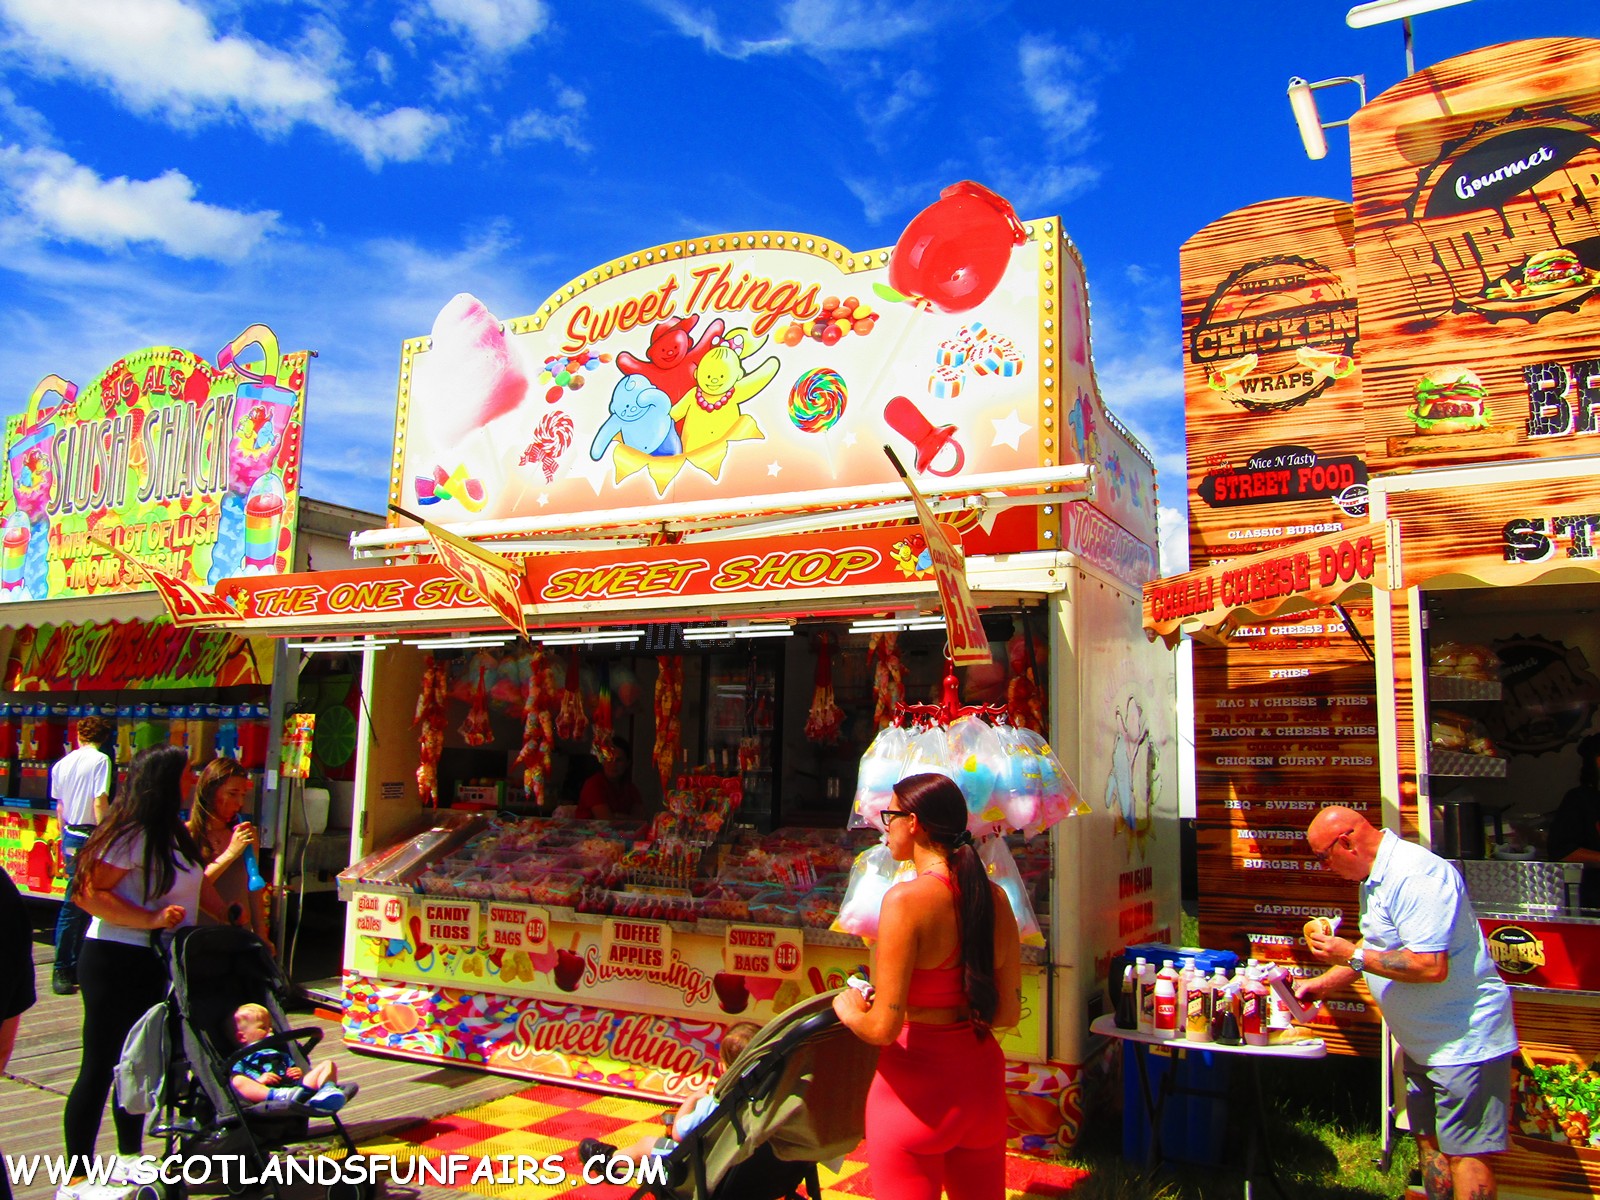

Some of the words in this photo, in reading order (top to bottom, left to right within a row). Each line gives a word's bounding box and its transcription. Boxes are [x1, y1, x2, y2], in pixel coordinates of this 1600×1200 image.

[1454, 146, 1554, 200] Gourmet
[561, 273, 679, 353] Sweet
[685, 261, 822, 336] Things
[1195, 309, 1359, 359] CHICKEN
[102, 376, 134, 413] BIG
[143, 364, 185, 397] AL'S
[1239, 371, 1315, 394] WRAPS
[49, 414, 133, 516] SLUSH
[138, 395, 234, 502] SHACK
[1249, 455, 1272, 470] Nice
[1274, 454, 1286, 467] N
[1287, 452, 1317, 469] Tasty
[1214, 470, 1291, 500] STREET
[1297, 463, 1355, 493] FOOD
[47, 534, 59, 561] A
[115, 524, 146, 553] LOT
[149, 521, 171, 550] OF
[171, 513, 221, 548] LUSH
[1228, 526, 1283, 540] CLASSIC
[1286, 522, 1343, 536] BURGER
[70, 561, 87, 590] IN
[87, 557, 120, 588] OUR
[255, 587, 323, 615] THE
[329, 583, 410, 610] ONE
[415, 575, 520, 608] STO
[544, 562, 705, 599] SWEET
[711, 548, 881, 589] SHOP
[1151, 575, 1215, 623] CHILLI
[1220, 551, 1311, 608] CHEESE
[1318, 536, 1376, 586] DOG
[1234, 626, 1266, 637] ILLI
[1269, 624, 1324, 635] CHEESE
[1327, 622, 1347, 634] DO
[1269, 668, 1309, 679] FRIES
[1216, 698, 1245, 709] MAC
[1250, 699, 1261, 708] N
[1264, 697, 1318, 708] CHEESE
[1327, 696, 1369, 706] FRIES
[1235, 712, 1290, 723] PULLED
[1210, 726, 1256, 738] BACON
[1260, 727, 1272, 738] &
[1276, 726, 1330, 737] CHEESE
[1334, 725, 1377, 736] FRIES
[1216, 756, 1274, 767] CHICKEN
[1278, 756, 1327, 766] CURRY
[1331, 755, 1374, 766] FRIES
[1224, 799, 1252, 810] BBQ
[1265, 800, 1316, 810] SWEET
[1243, 859, 1300, 871] BURGER
[358, 895, 379, 912] giant
[1254, 904, 1344, 917] CAPPUCCINO
[426, 906, 470, 922] CANDY
[490, 907, 526, 925] SWEET
[429, 924, 470, 940] FLOSS
[494, 930, 522, 946] BAGS
[614, 922, 660, 944] TOFFEE
[729, 930, 776, 948] SWEET
[1247, 934, 1294, 946] WHITE
[609, 945, 664, 968] APPLES
[734, 955, 769, 973] BAGS
[1328, 1001, 1366, 1013] TEAS
[508, 1009, 611, 1060] Sweet
[612, 1015, 714, 1090] things
